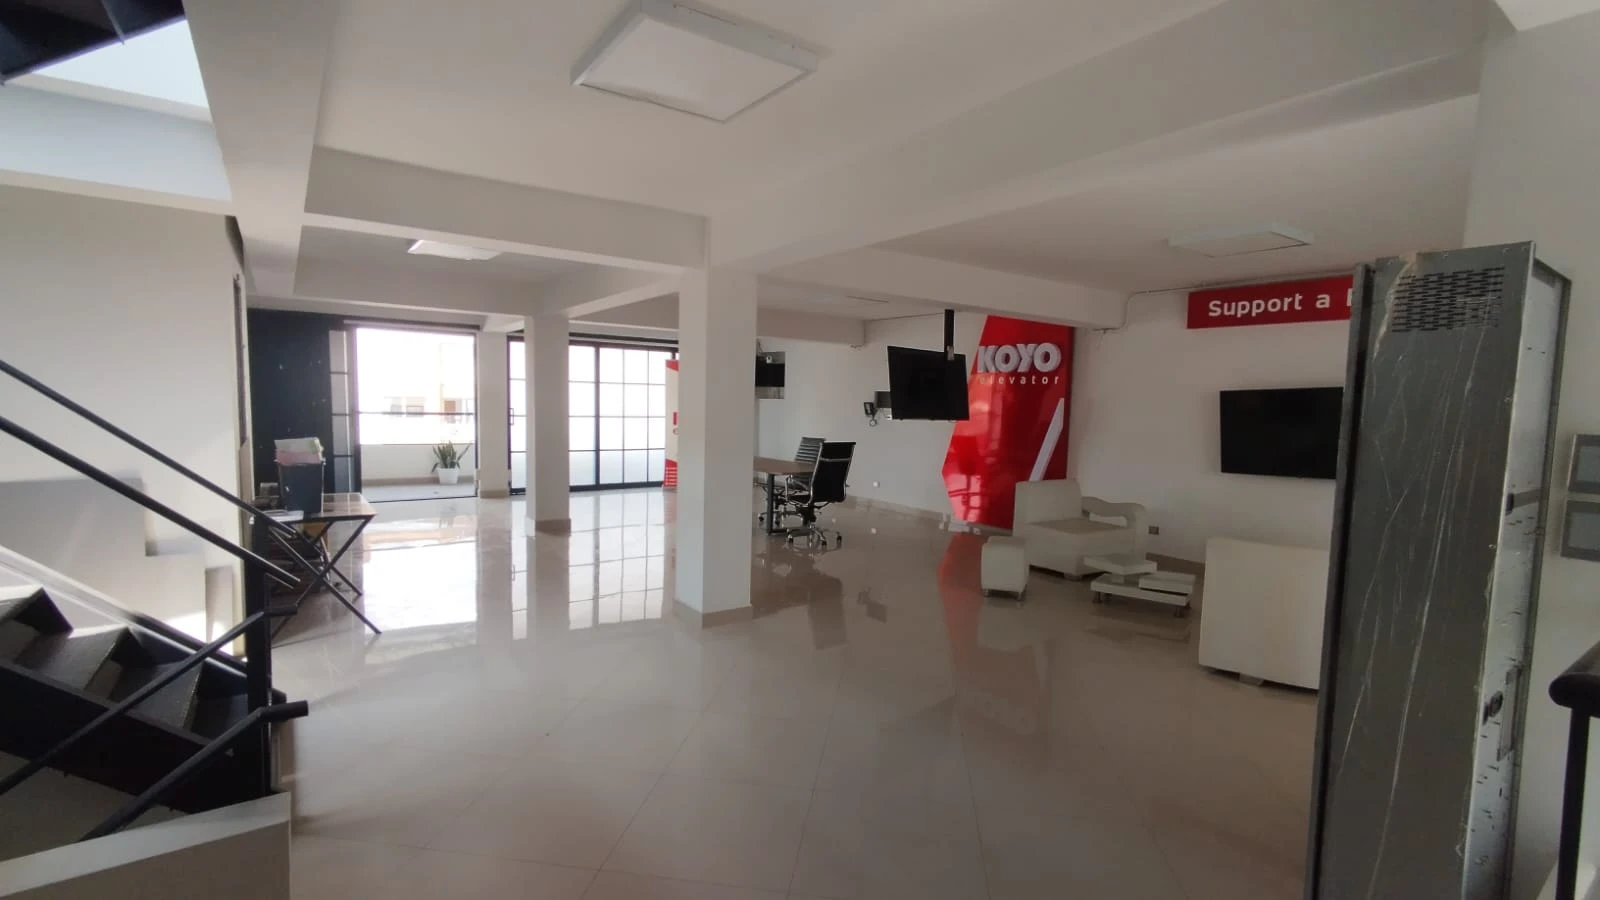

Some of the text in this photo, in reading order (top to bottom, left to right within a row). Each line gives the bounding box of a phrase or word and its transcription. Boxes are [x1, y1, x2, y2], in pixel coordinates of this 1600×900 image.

[1208, 293, 1303, 318] Support
[1315, 293, 1331, 309] a
[977, 342, 1062, 373] KOYO
